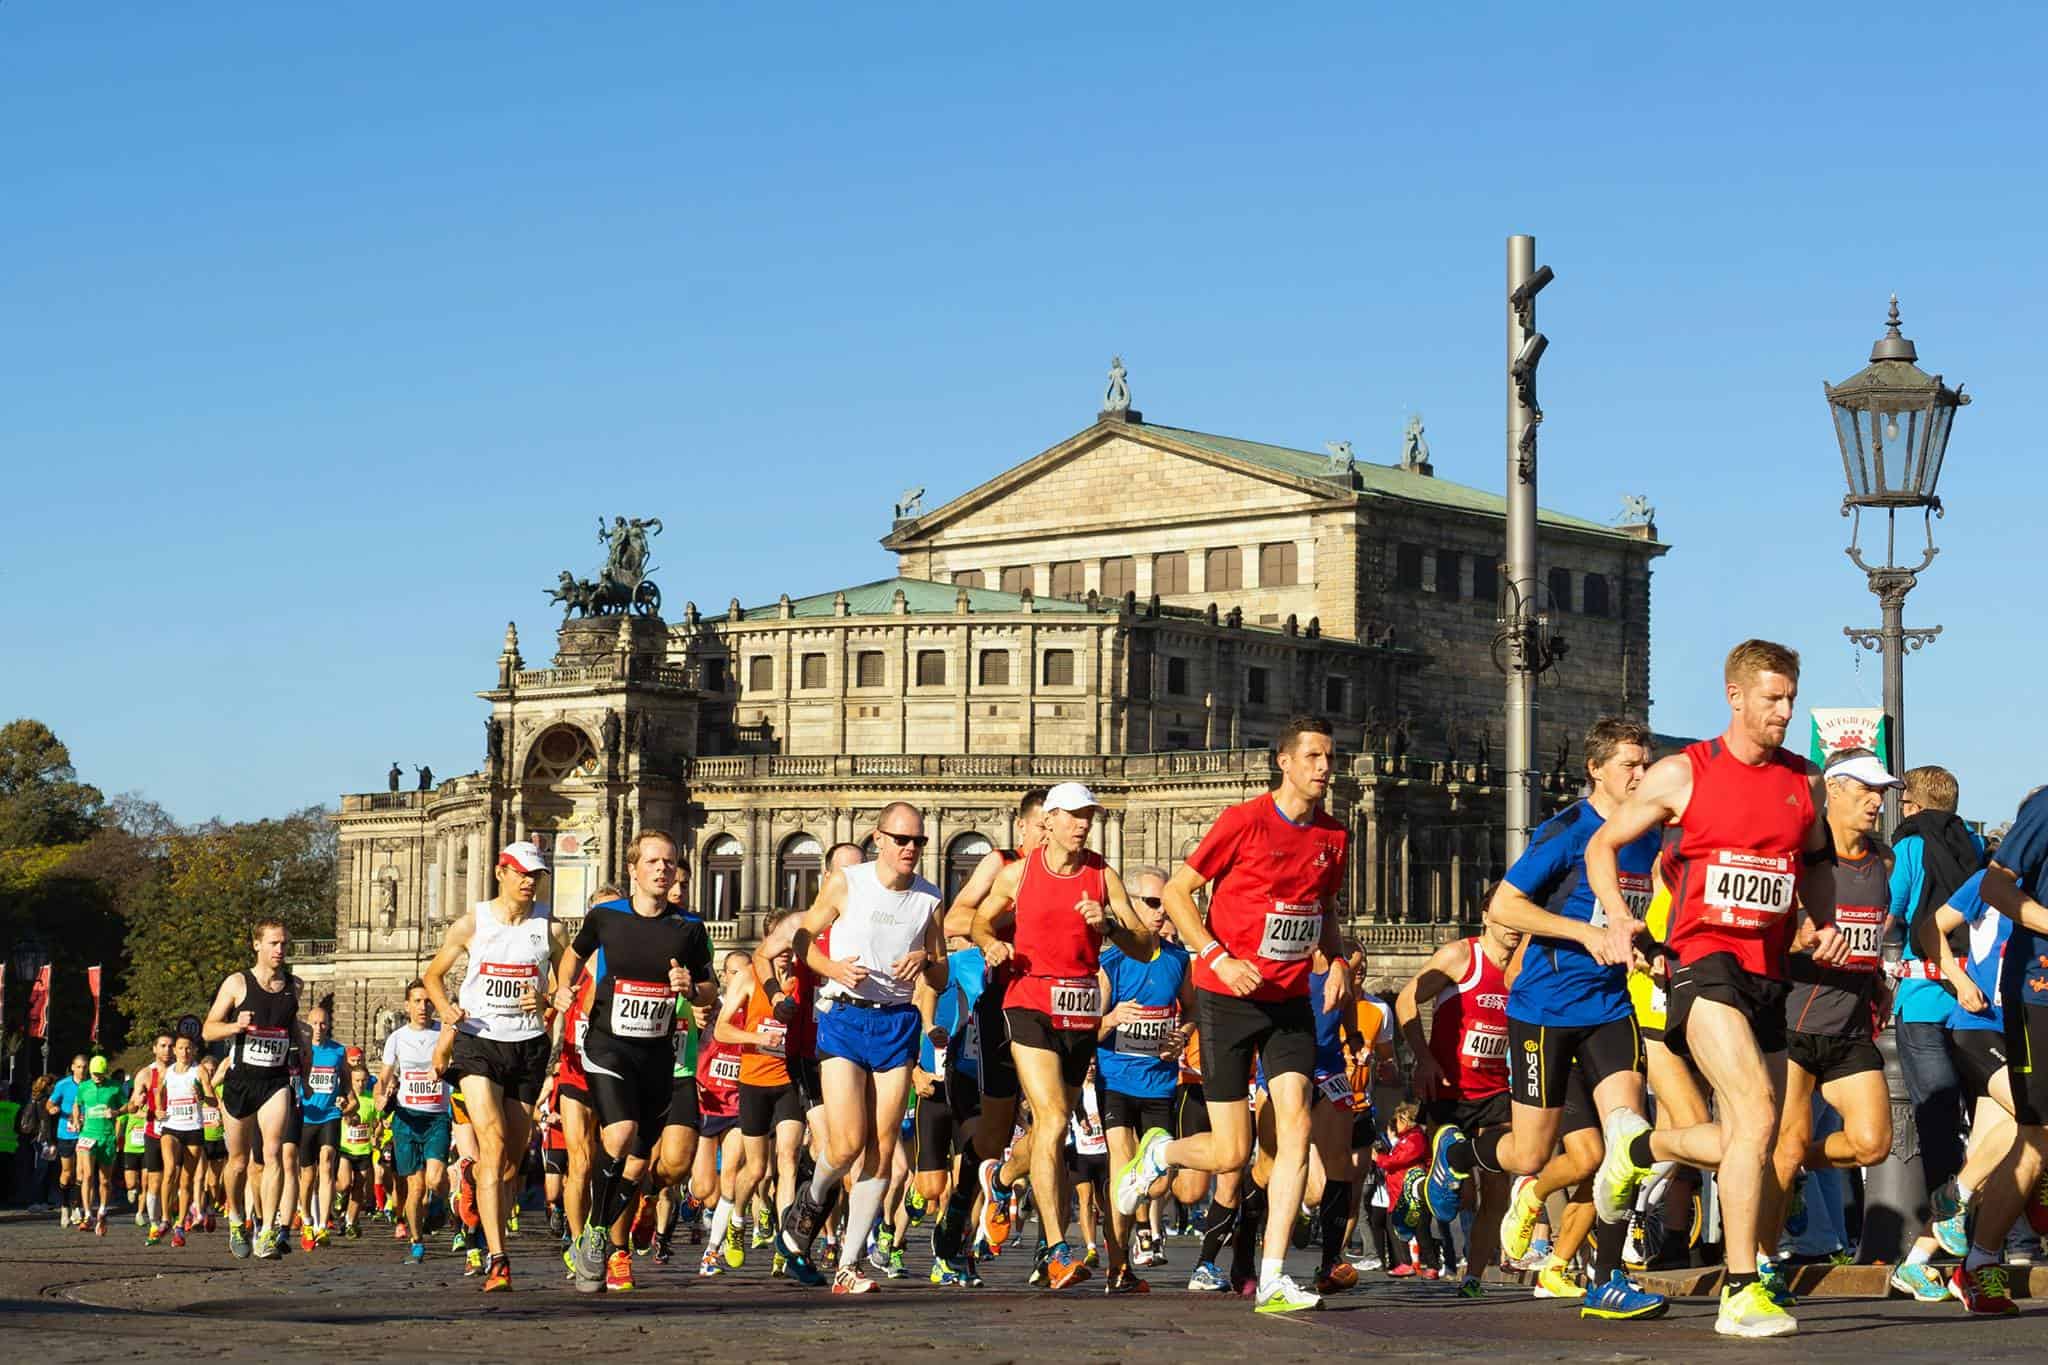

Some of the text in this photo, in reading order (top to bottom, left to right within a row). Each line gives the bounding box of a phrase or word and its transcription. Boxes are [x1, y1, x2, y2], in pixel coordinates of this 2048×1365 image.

[1717, 873, 1782, 907] 40206
[1271, 918, 1314, 942] 20124
[1843, 927, 1877, 951] 0133
[620, 998, 665, 1020] 20470
[1058, 992, 1096, 1012] 40121
[249, 1038, 284, 1055] 21561
